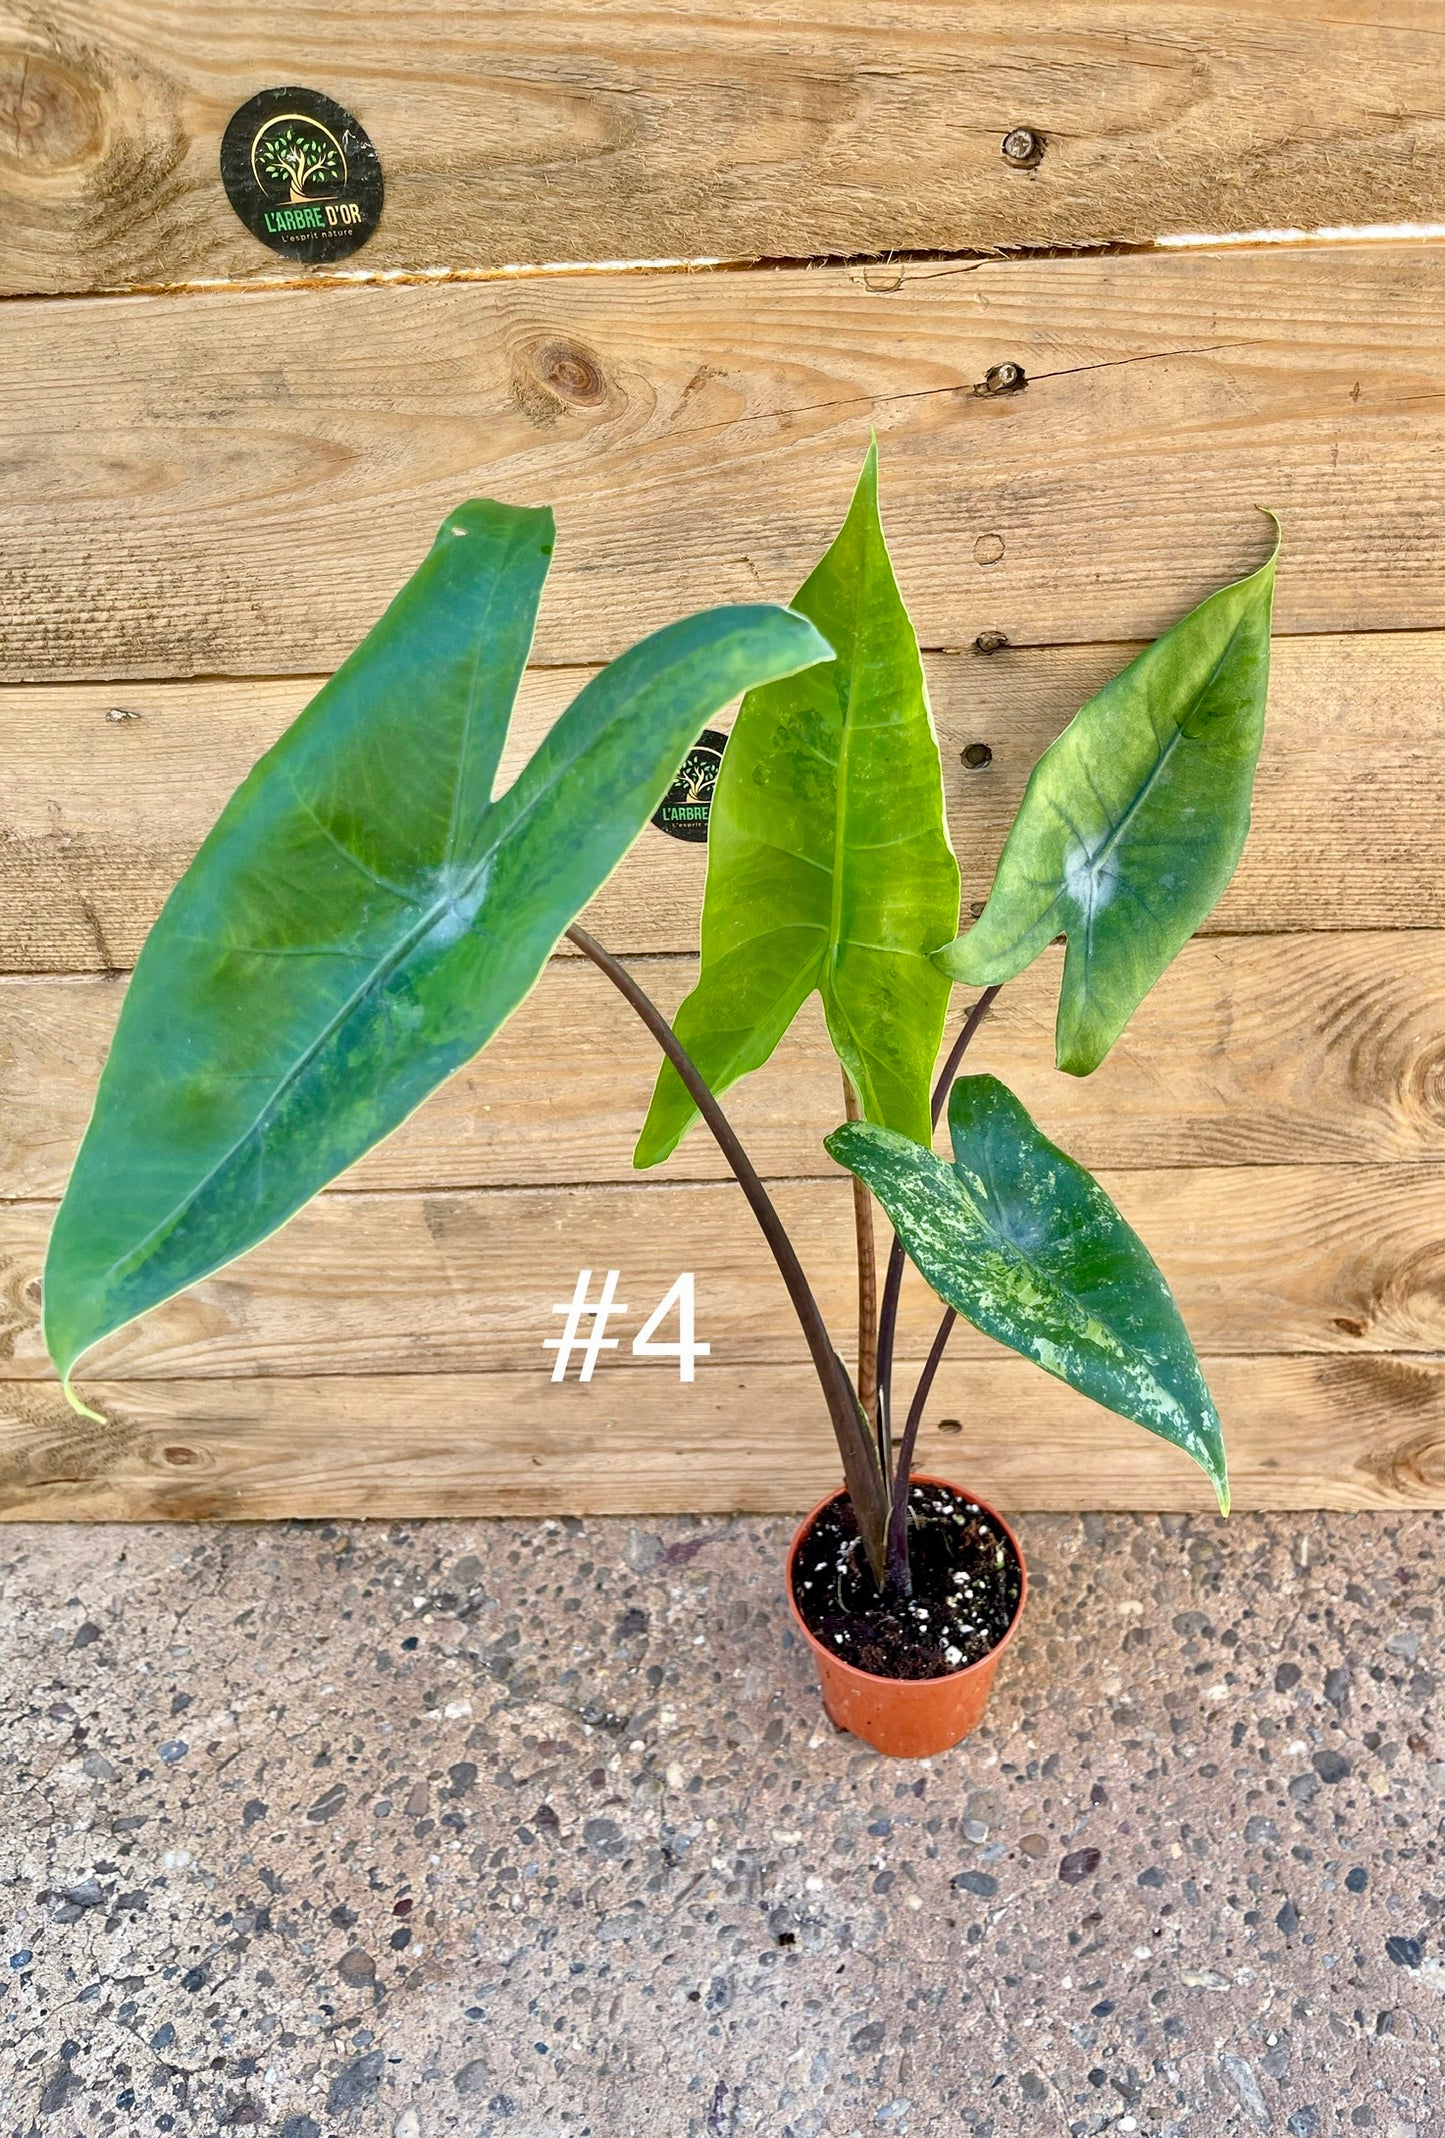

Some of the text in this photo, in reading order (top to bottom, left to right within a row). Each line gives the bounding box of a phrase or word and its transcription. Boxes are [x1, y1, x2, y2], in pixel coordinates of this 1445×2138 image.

[264, 203, 362, 232] L'ARBRE D'OR
[281, 229, 353, 243] L'esprit nature
[662, 806, 709, 820] L'ARBRE
